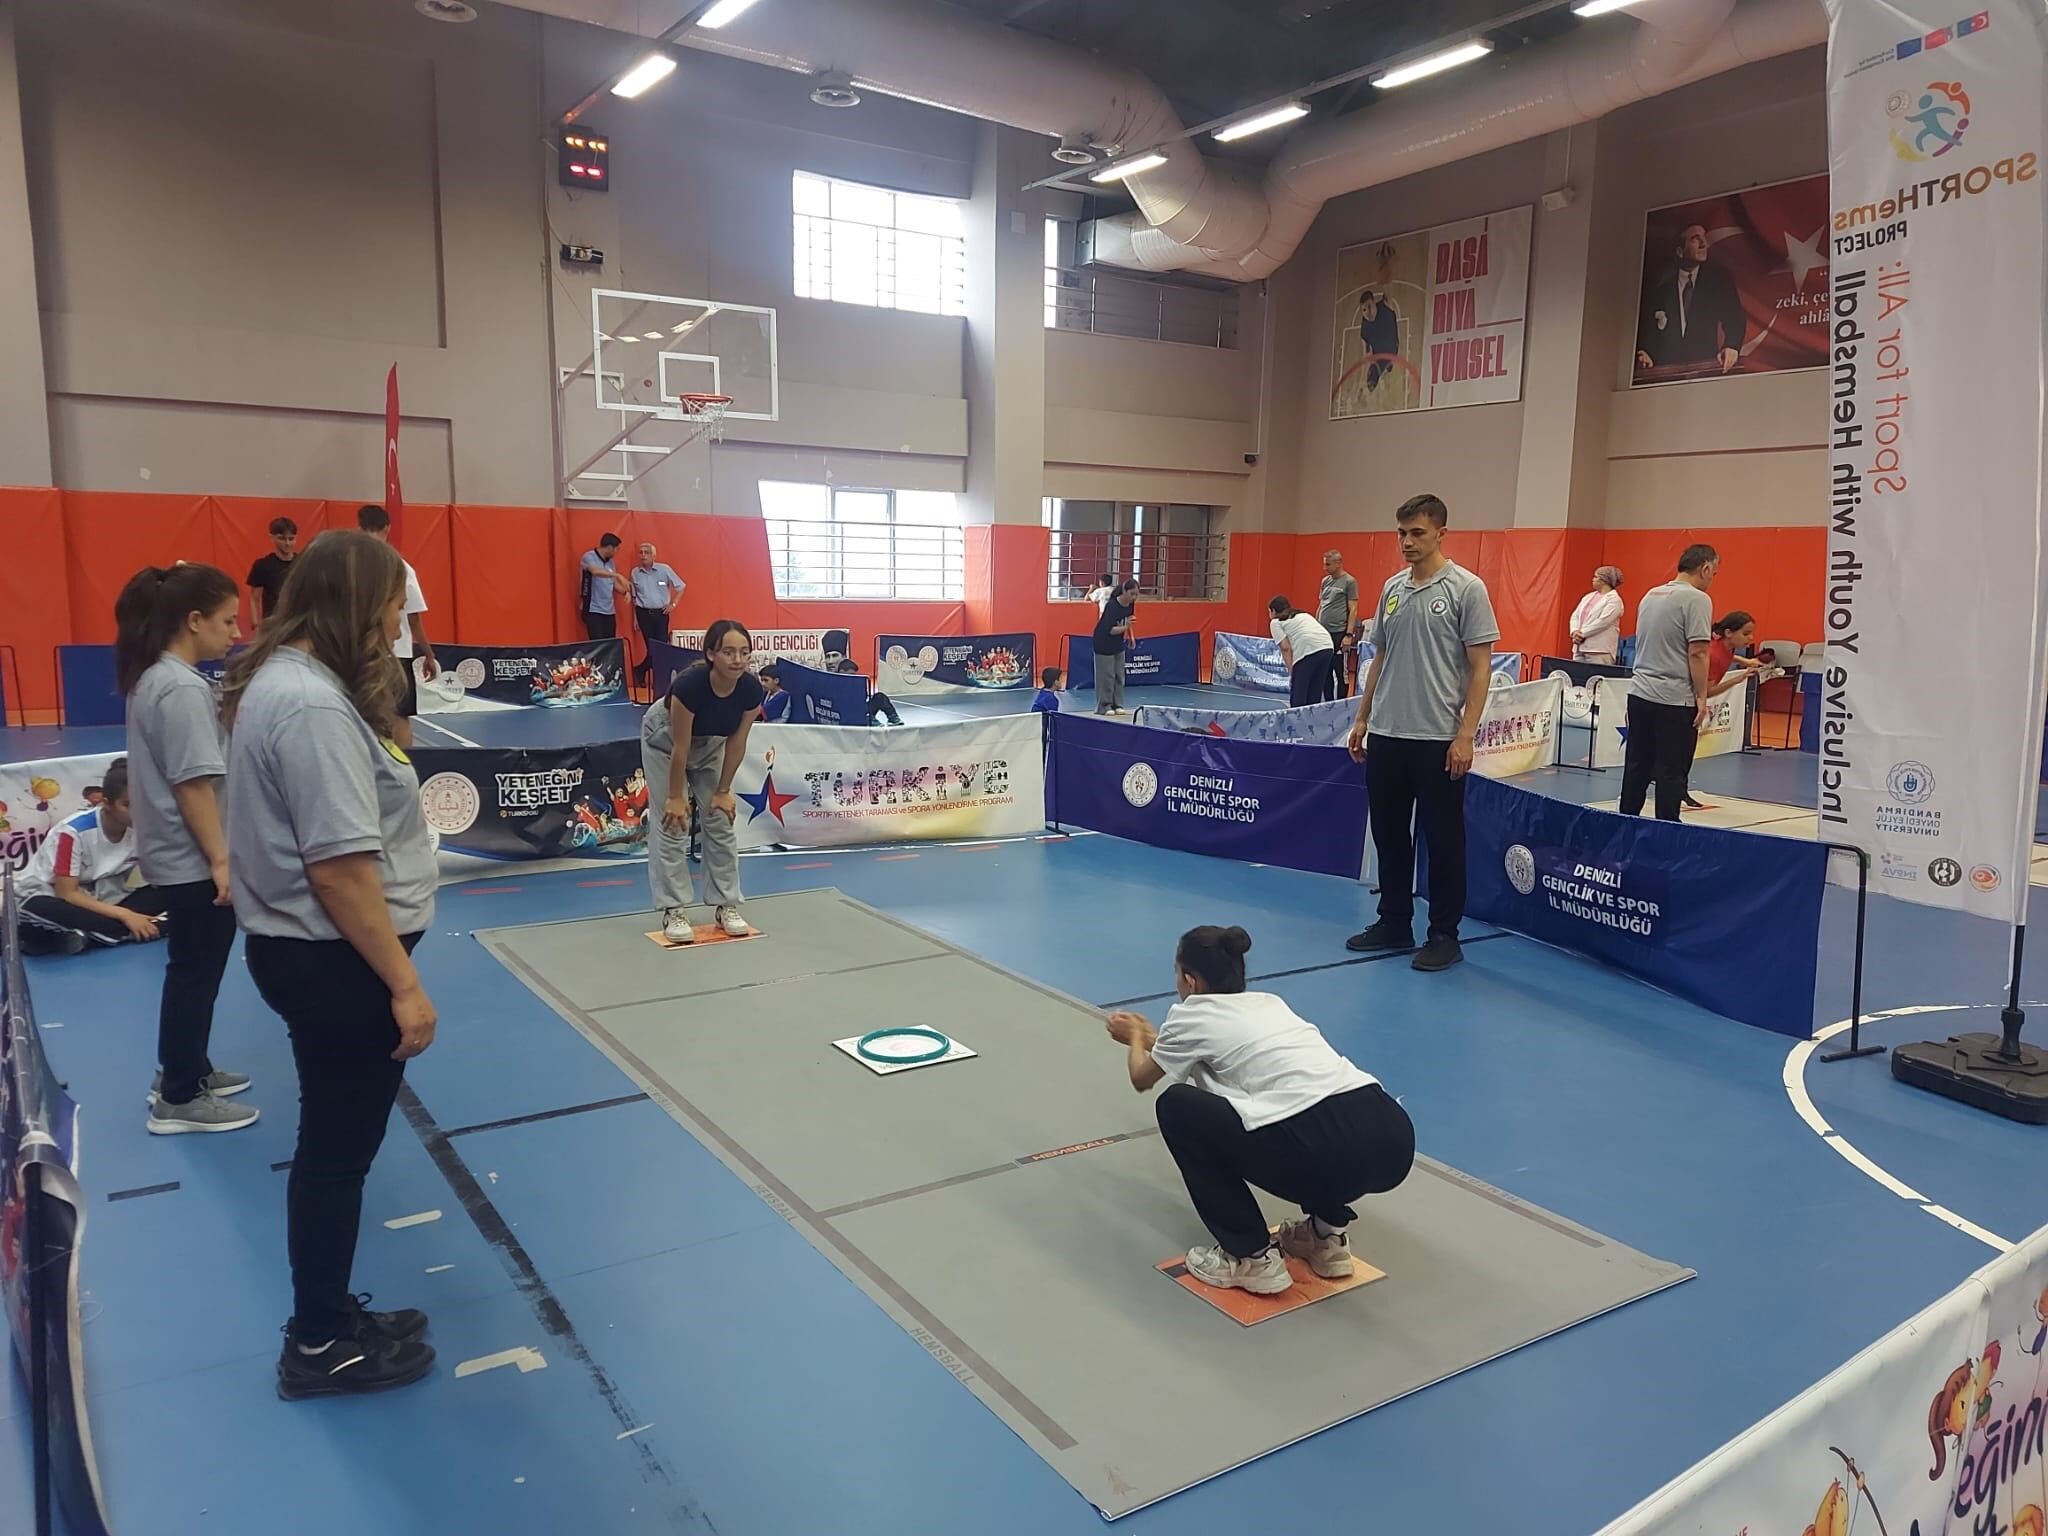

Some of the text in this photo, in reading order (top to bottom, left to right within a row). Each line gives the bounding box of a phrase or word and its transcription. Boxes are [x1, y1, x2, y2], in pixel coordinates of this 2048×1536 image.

[1436, 233, 1488, 284] BAŞA
[1432, 288, 1476, 335] RIYA
[1775, 292, 1829, 309] zeki, çe
[1799, 308, 1830, 325] ahlâ
[1430, 335, 1508, 385] YÜKSEL
[773, 633, 819, 652] GENÇLİĞİ
[495, 768, 584, 789] YETENEĞİNİ
[803, 759, 1010, 808] TÜRKİYE
[1190, 774, 1234, 792] DENİZLİ
[499, 785, 572, 809] KEŞFET
[1164, 786, 1260, 810] GENÇLİK VE SPOR
[1167, 800, 1255, 823] İL MÜDÜRLÜĞÜ
[1574, 863, 1622, 889] DENİZLİ
[1542, 874, 1660, 917] GENÇLİK VE SPOR
[1548, 893, 1652, 936] İL MÜDÜRLÜĞÜ
[910, 1327, 976, 1386] HEMSBALL
